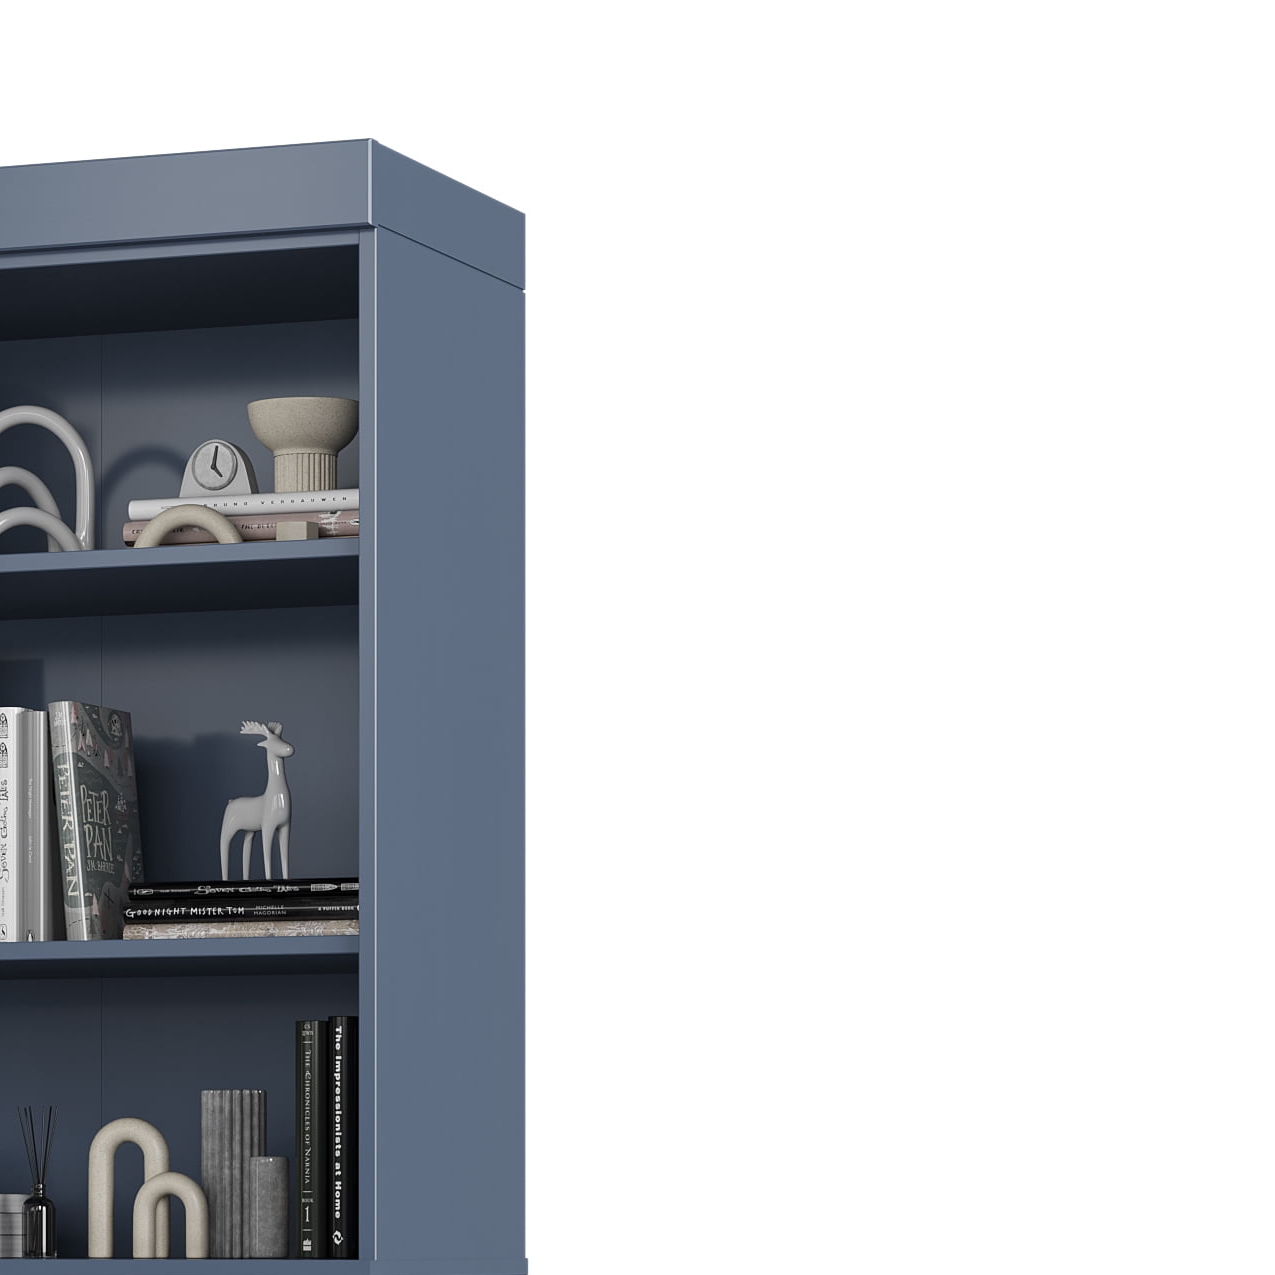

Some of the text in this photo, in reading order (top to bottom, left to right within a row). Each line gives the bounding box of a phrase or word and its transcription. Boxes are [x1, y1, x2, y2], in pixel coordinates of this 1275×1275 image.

[57, 763, 80, 897] PETER PAN
[80, 784, 111, 825] PETER
[84, 823, 113, 861] PAN
[190, 906, 225, 916] MISTER
[303, 1049, 312, 1184] THE CHRONICLES OF NARNIA
[333, 1025, 343, 1219] The Impressionists at Home
